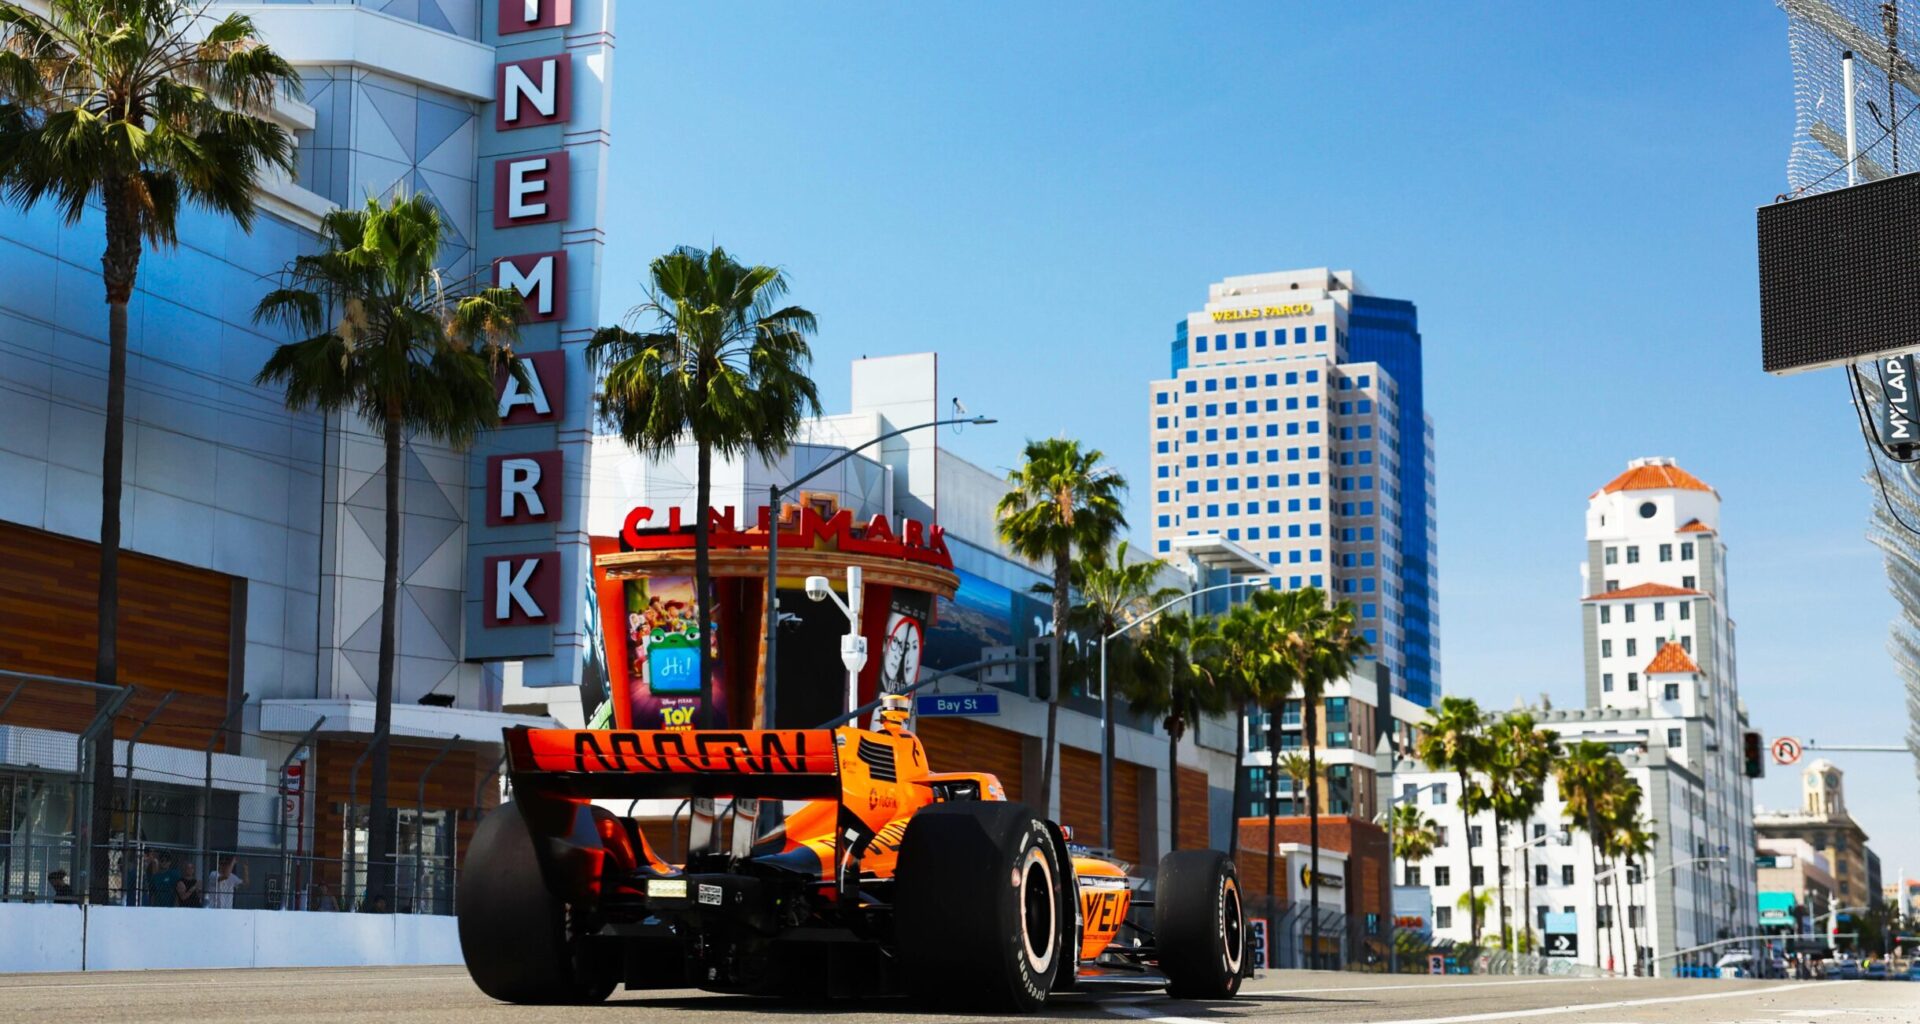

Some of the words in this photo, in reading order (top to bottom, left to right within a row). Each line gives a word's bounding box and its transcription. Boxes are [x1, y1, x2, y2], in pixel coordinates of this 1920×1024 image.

[1212, 308, 1261, 321] WELLS
[1264, 303, 1313, 317] FARGO
[661, 657, 692, 676] Hi!
[937, 699, 960, 712] Bay
[964, 699, 978, 710] St
[660, 706, 695, 725] TOY
[574, 731, 805, 773] ARROW
